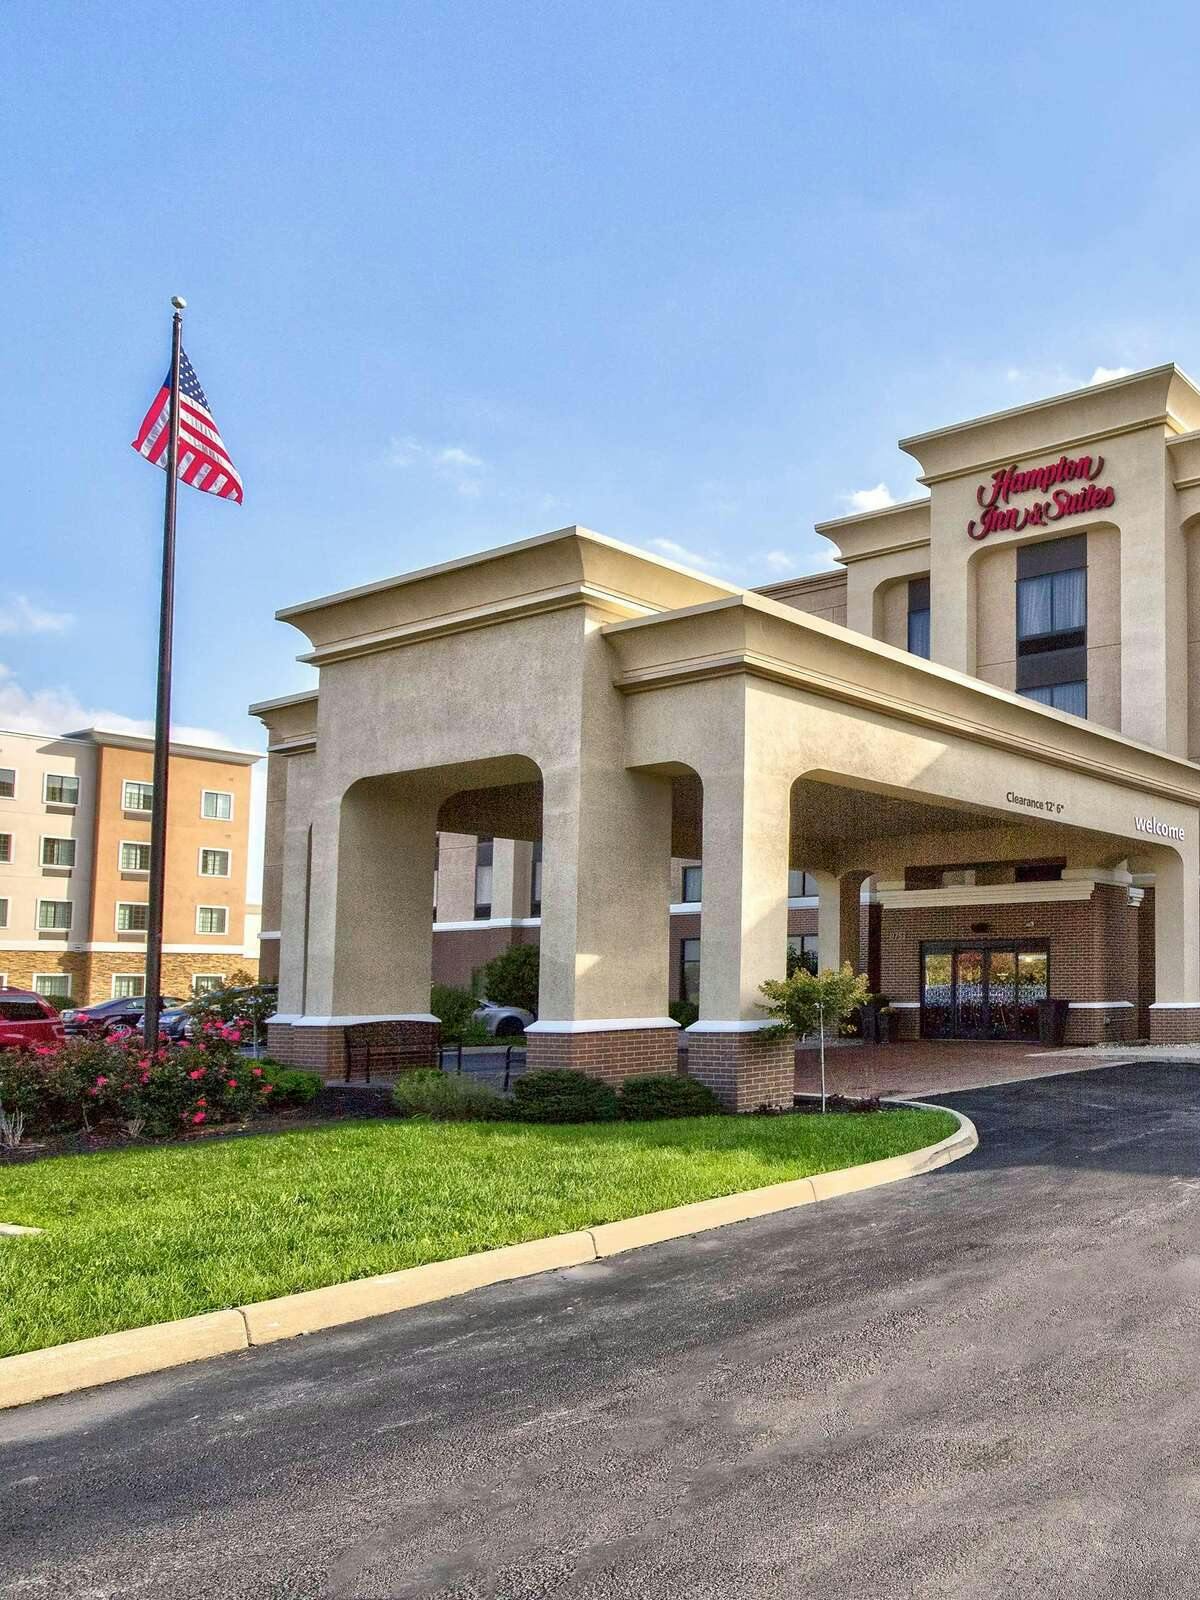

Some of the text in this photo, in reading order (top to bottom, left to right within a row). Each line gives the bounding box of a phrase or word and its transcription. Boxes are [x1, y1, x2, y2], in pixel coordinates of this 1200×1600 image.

[976, 455, 1104, 507] Hampton
[967, 484, 1115, 541] Inn & Suites
[1006, 791, 1044, 810] Clearance
[1134, 816, 1185, 841] welcome
